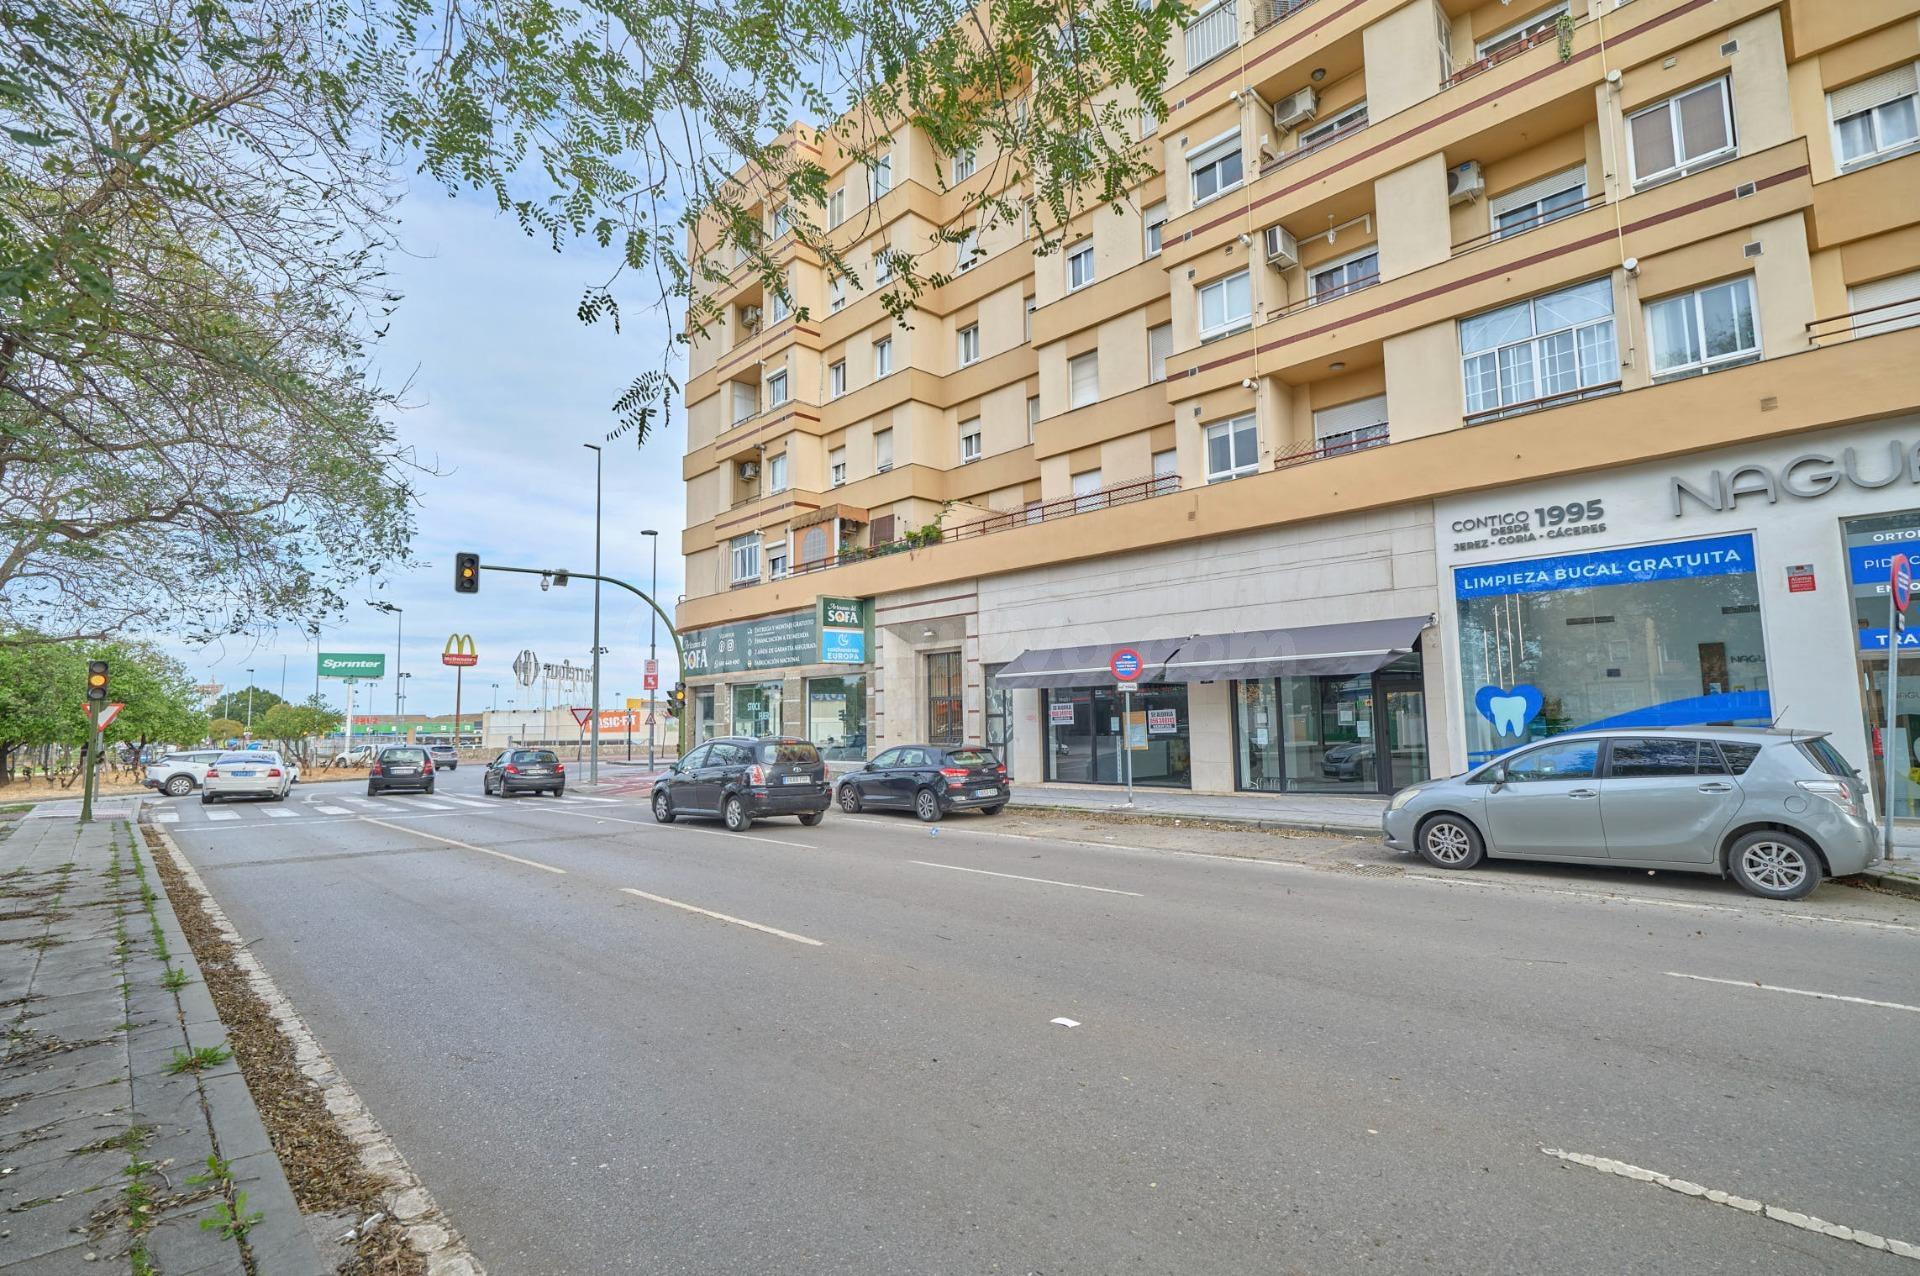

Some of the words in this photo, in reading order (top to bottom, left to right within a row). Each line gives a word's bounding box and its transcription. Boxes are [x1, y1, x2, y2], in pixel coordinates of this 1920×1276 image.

[1670, 439, 1920, 517] NAGU
[1451, 510, 1530, 533] CONTIGO
[1534, 498, 1605, 528] 1995
[1453, 538, 1489, 552] JEREZ
[1498, 532, 1537, 546] CORIA
[1546, 523, 1607, 540] CÁCERES
[1490, 522, 1530, 537] DESDE
[1873, 528, 1920, 541] ORTO
[1463, 569, 1550, 591] LIMPIEZA
[1554, 561, 1625, 582] BUCAL
[1628, 549, 1742, 573] GRATUITA
[828, 610, 858, 624] SOFA
[323, 658, 381, 669] Sprinter
[827, 652, 859, 660] EUROPA
